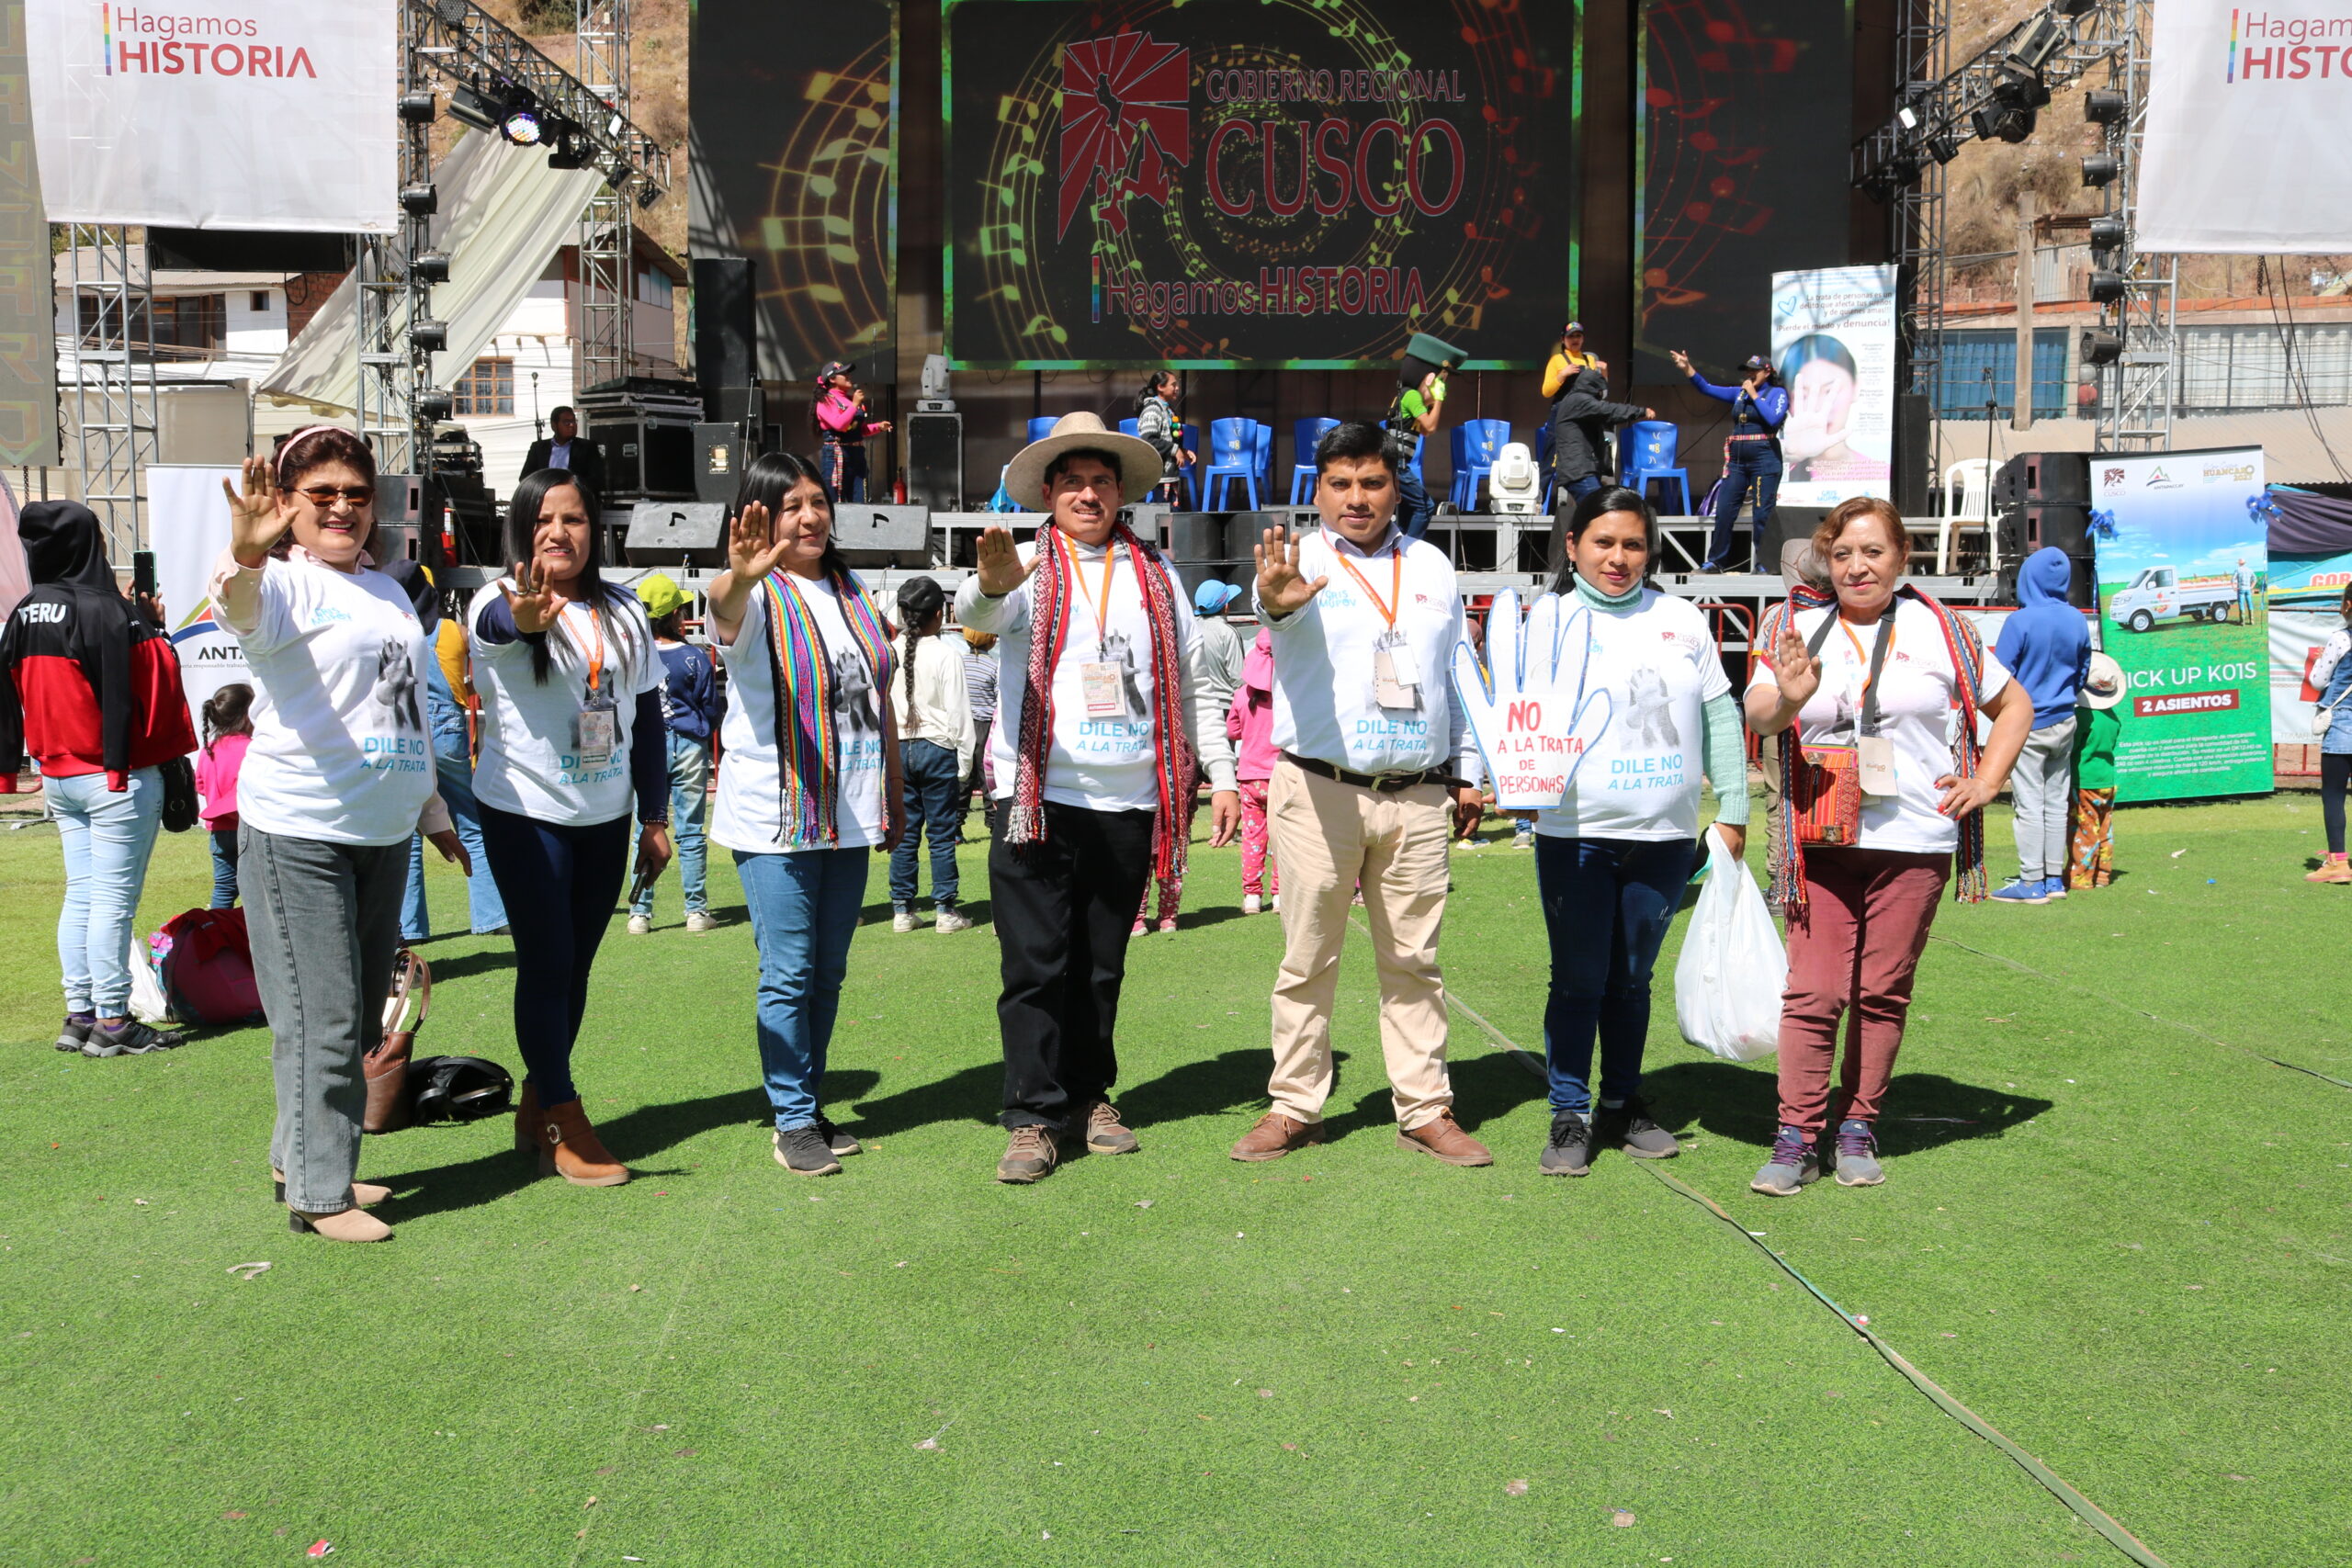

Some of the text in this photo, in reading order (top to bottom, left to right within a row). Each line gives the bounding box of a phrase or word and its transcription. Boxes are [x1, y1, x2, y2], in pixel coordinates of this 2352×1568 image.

[117, 6, 257, 40] Hagamos
[119, 41, 318, 78] HISTORIA
[1205, 69, 1466, 102] GOBIERNO REGIONAL
[1205, 118, 1465, 217] CUSCO
[1843, 292, 1873, 301] personas
[2171, 667, 2201, 685] UP
[2208, 662, 2257, 682] K01S
[2142, 694, 2232, 713] 2 ASIENTOS
[1507, 700, 1542, 733] NO
[1079, 721, 1148, 737] DILE NO
[1356, 719, 1428, 735] DILE NO
[364, 738, 424, 755] DILE NO
[839, 740, 861, 756] ILE
[1076, 739, 1148, 753] A LA TRATA
[1353, 739, 1427, 751] A LA TRATA
[1497, 735, 1584, 755] A LA TRATA
[359, 759, 426, 773] A LA TRATA
[1519, 759, 1536, 771] DE
[1611, 753, 1683, 774] DILE NO
[559, 766, 624, 784] A LA TRATA
[1608, 773, 1684, 791] A LA TRATA
[1498, 774, 1565, 795] PERSONAS
